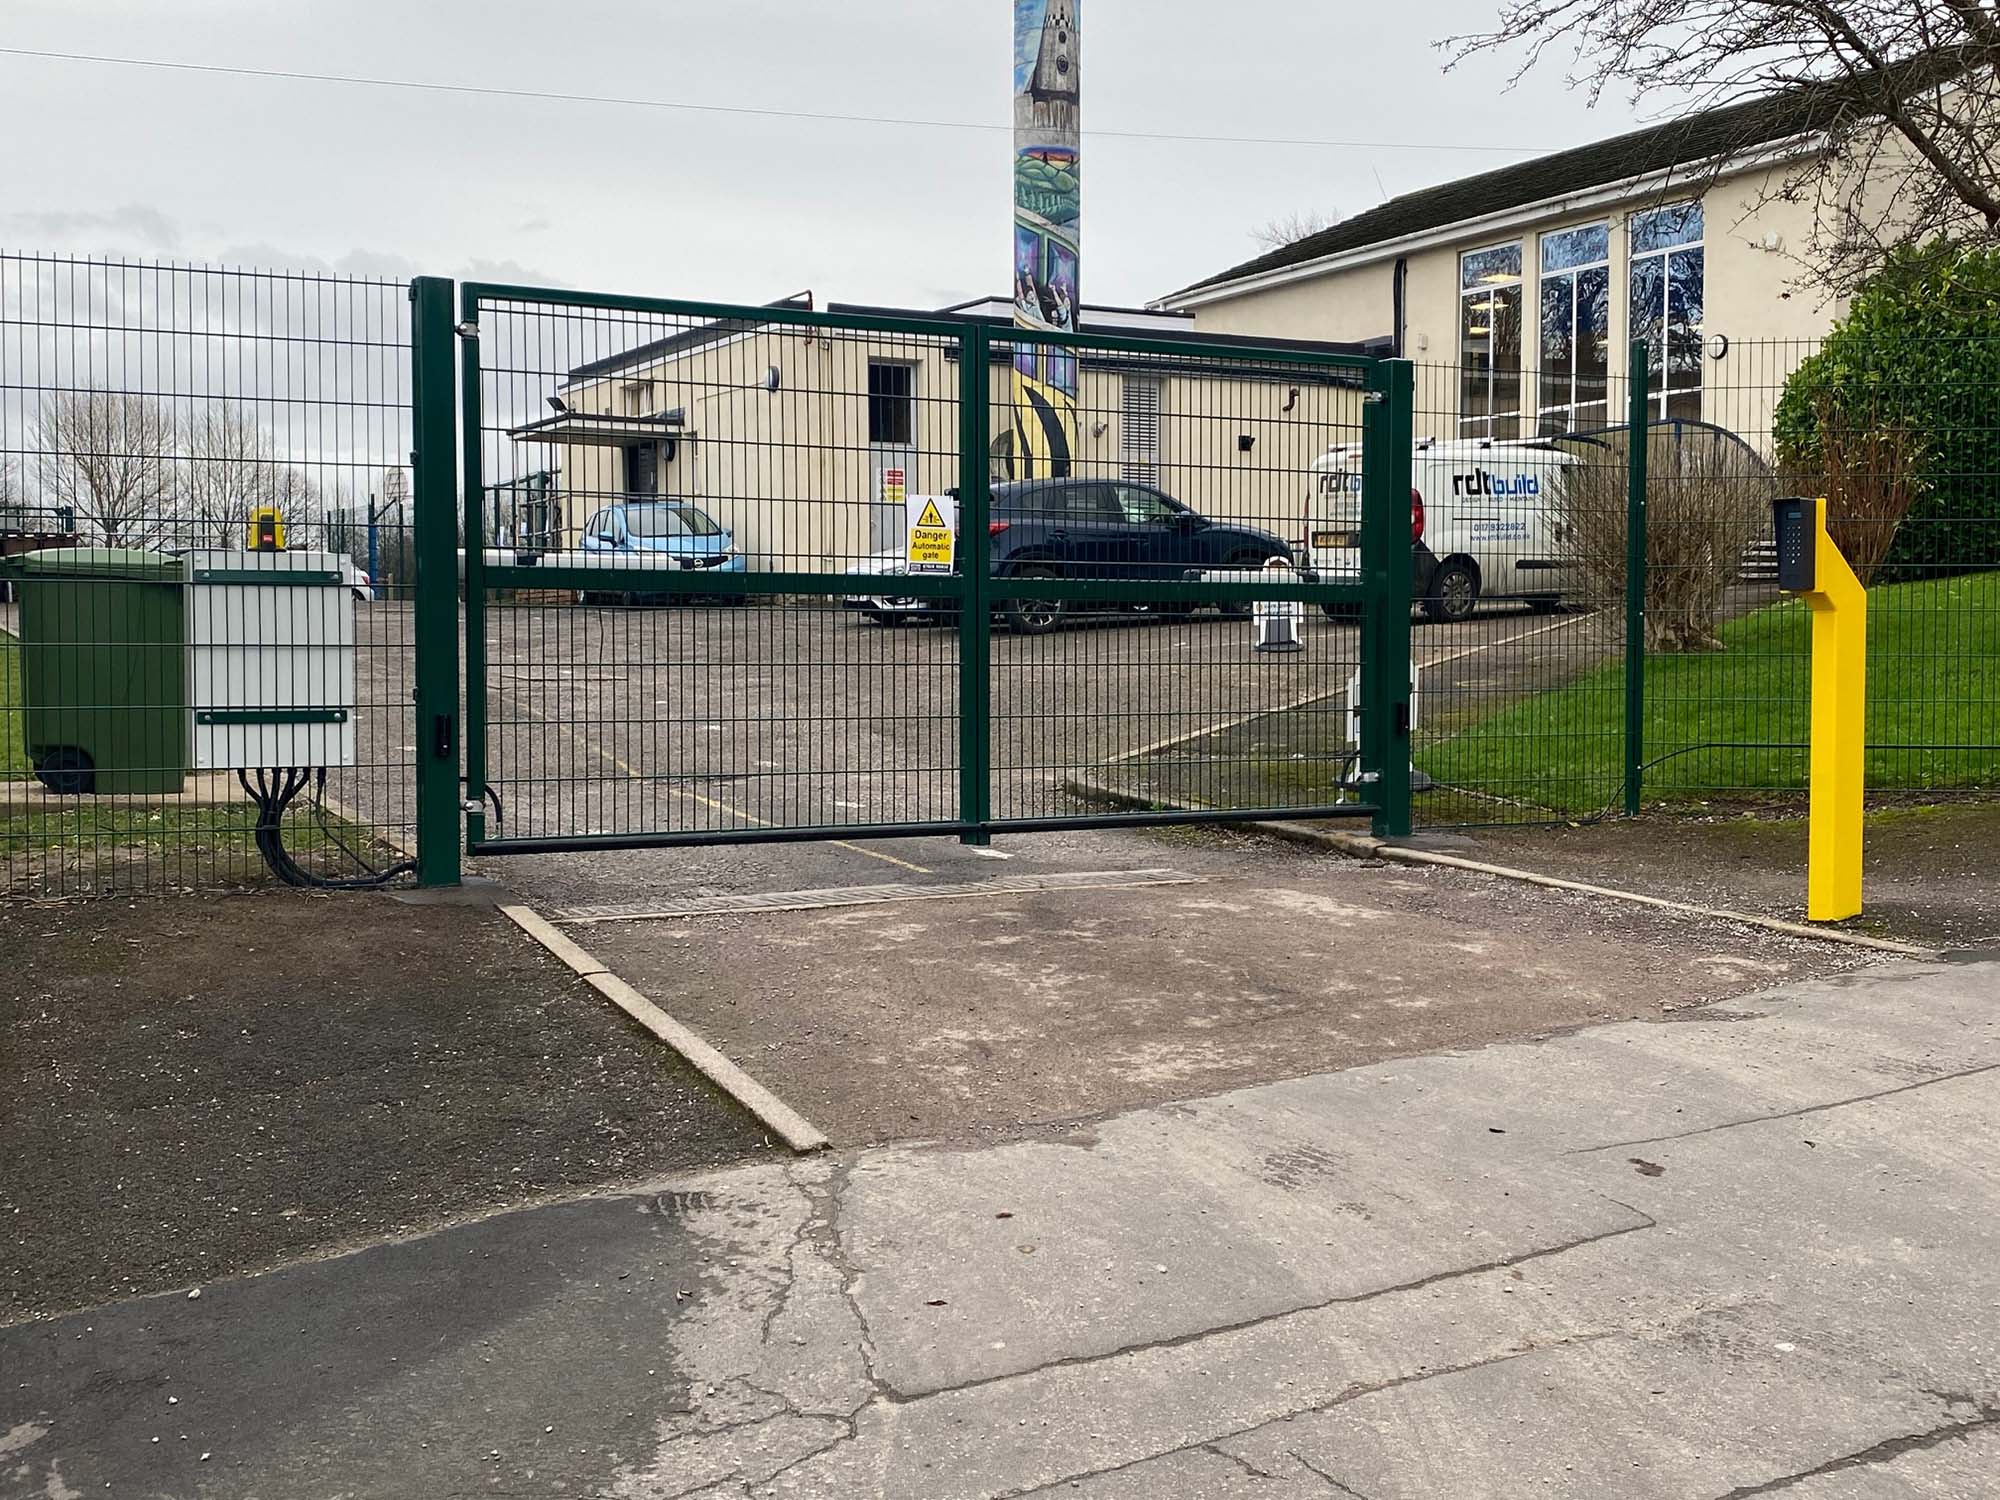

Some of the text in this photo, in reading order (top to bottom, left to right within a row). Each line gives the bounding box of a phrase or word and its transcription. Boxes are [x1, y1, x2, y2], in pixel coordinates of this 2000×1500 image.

[915, 530, 947, 541] Danger
[912, 542, 950, 551] Automatic
[922, 552, 939, 561] gate
